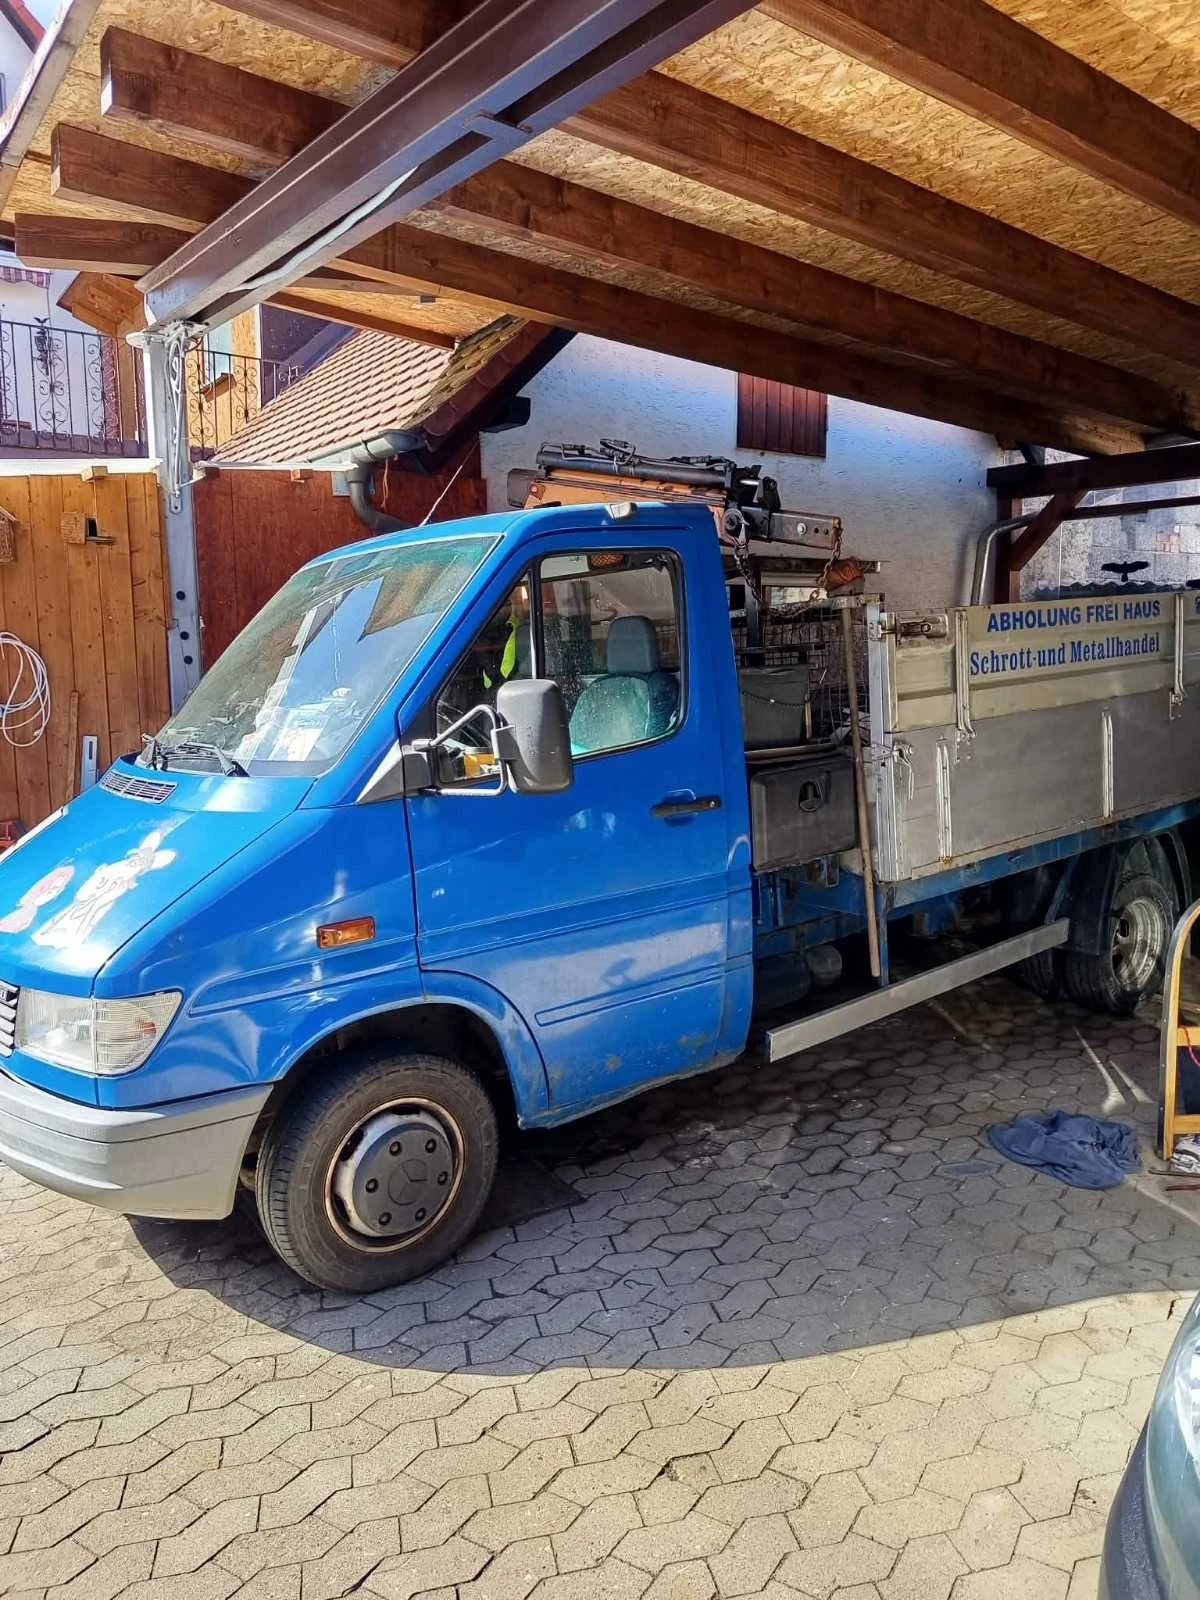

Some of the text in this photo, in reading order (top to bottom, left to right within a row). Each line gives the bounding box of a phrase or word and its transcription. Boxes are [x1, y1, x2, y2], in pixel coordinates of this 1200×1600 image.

[987, 600, 1160, 633] ABHOLUNG FREI HAUS
[1070, 632, 1160, 663] Metallhandel
